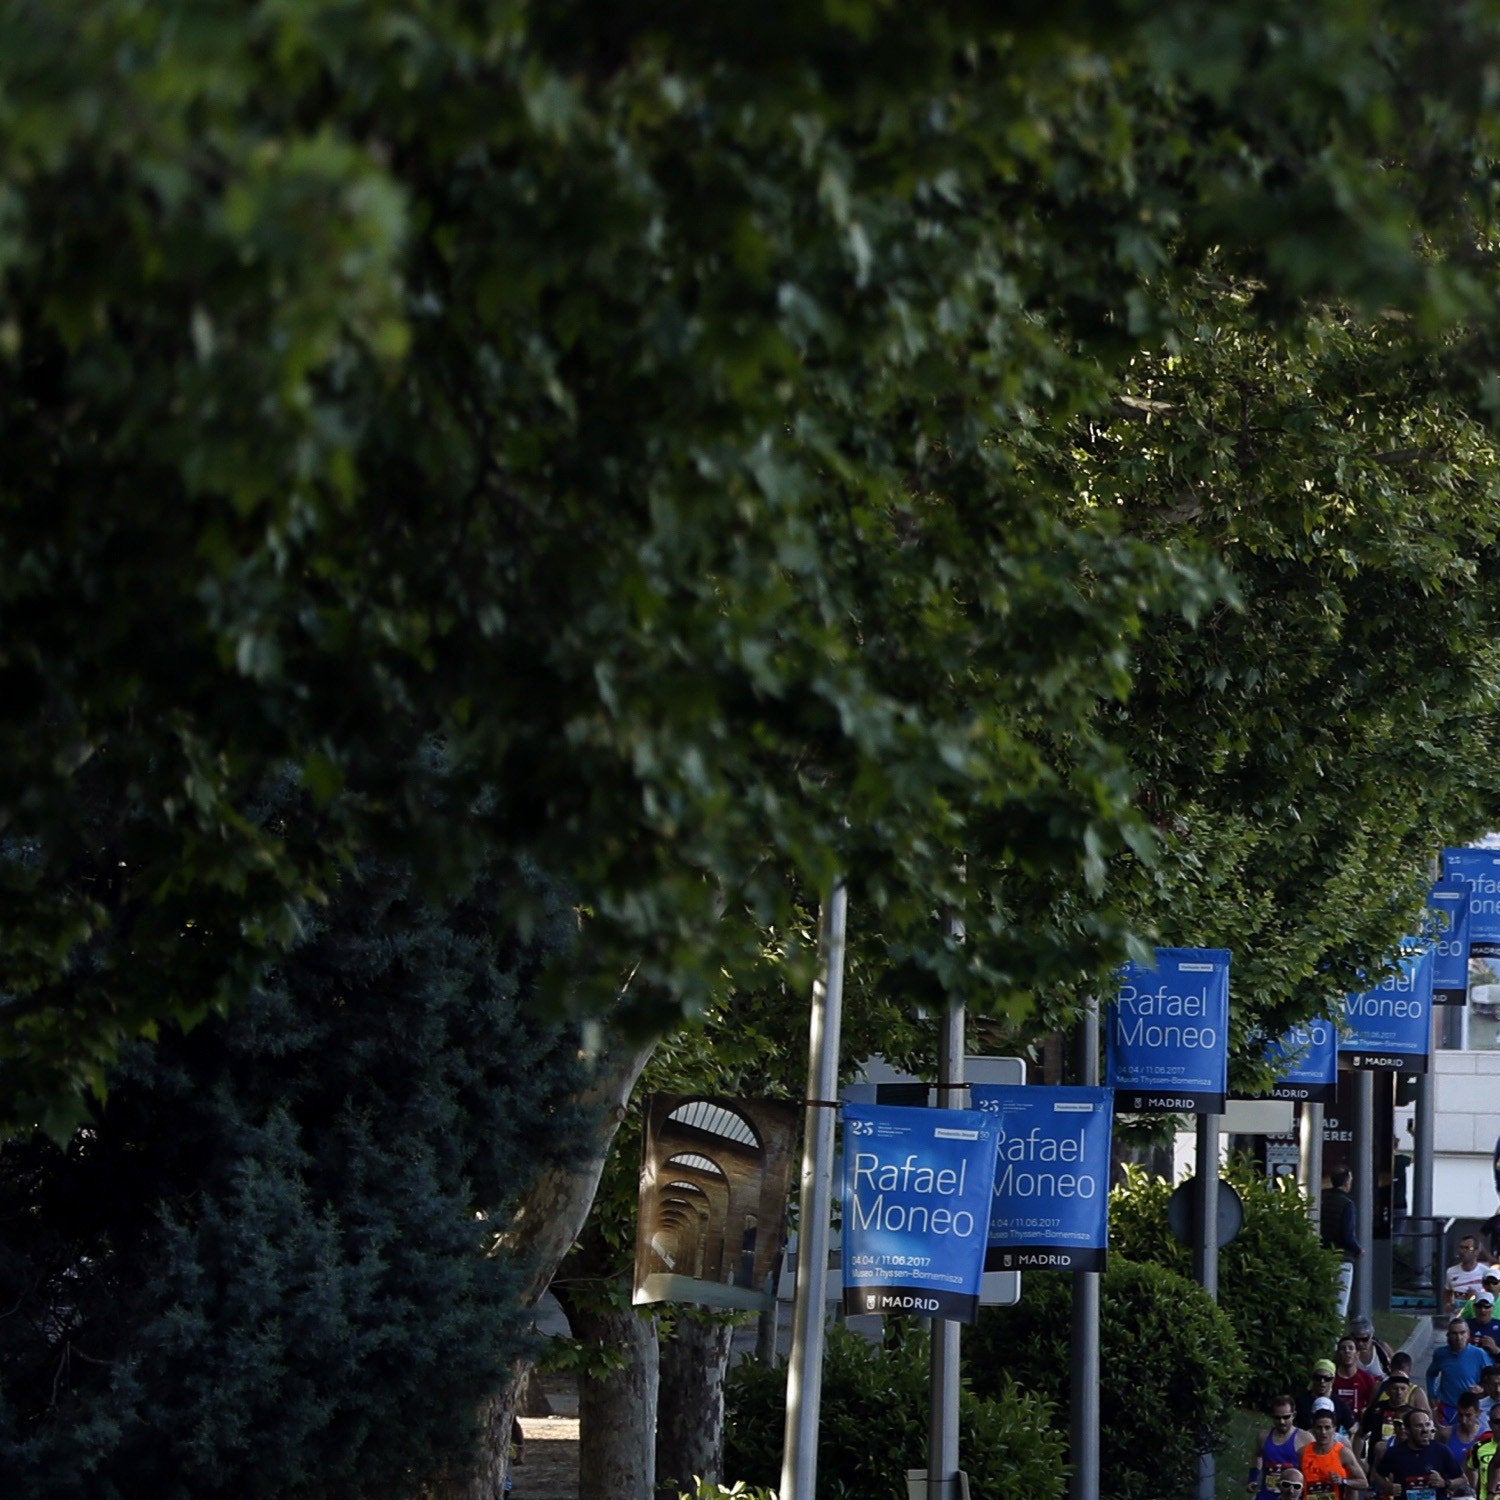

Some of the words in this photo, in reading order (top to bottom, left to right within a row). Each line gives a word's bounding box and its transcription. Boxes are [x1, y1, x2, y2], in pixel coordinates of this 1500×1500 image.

[1117, 985, 1207, 1017] Rafael
[1116, 1017, 1216, 1050] Moneo
[1365, 1056, 1404, 1067] MADRID
[1148, 1098, 1195, 1109] MADRID
[853, 1153, 966, 1197] Rafael
[852, 1193, 974, 1238] Moneo
[1018, 1254, 1071, 1266] MADRID
[882, 1295, 940, 1311] MADRID
